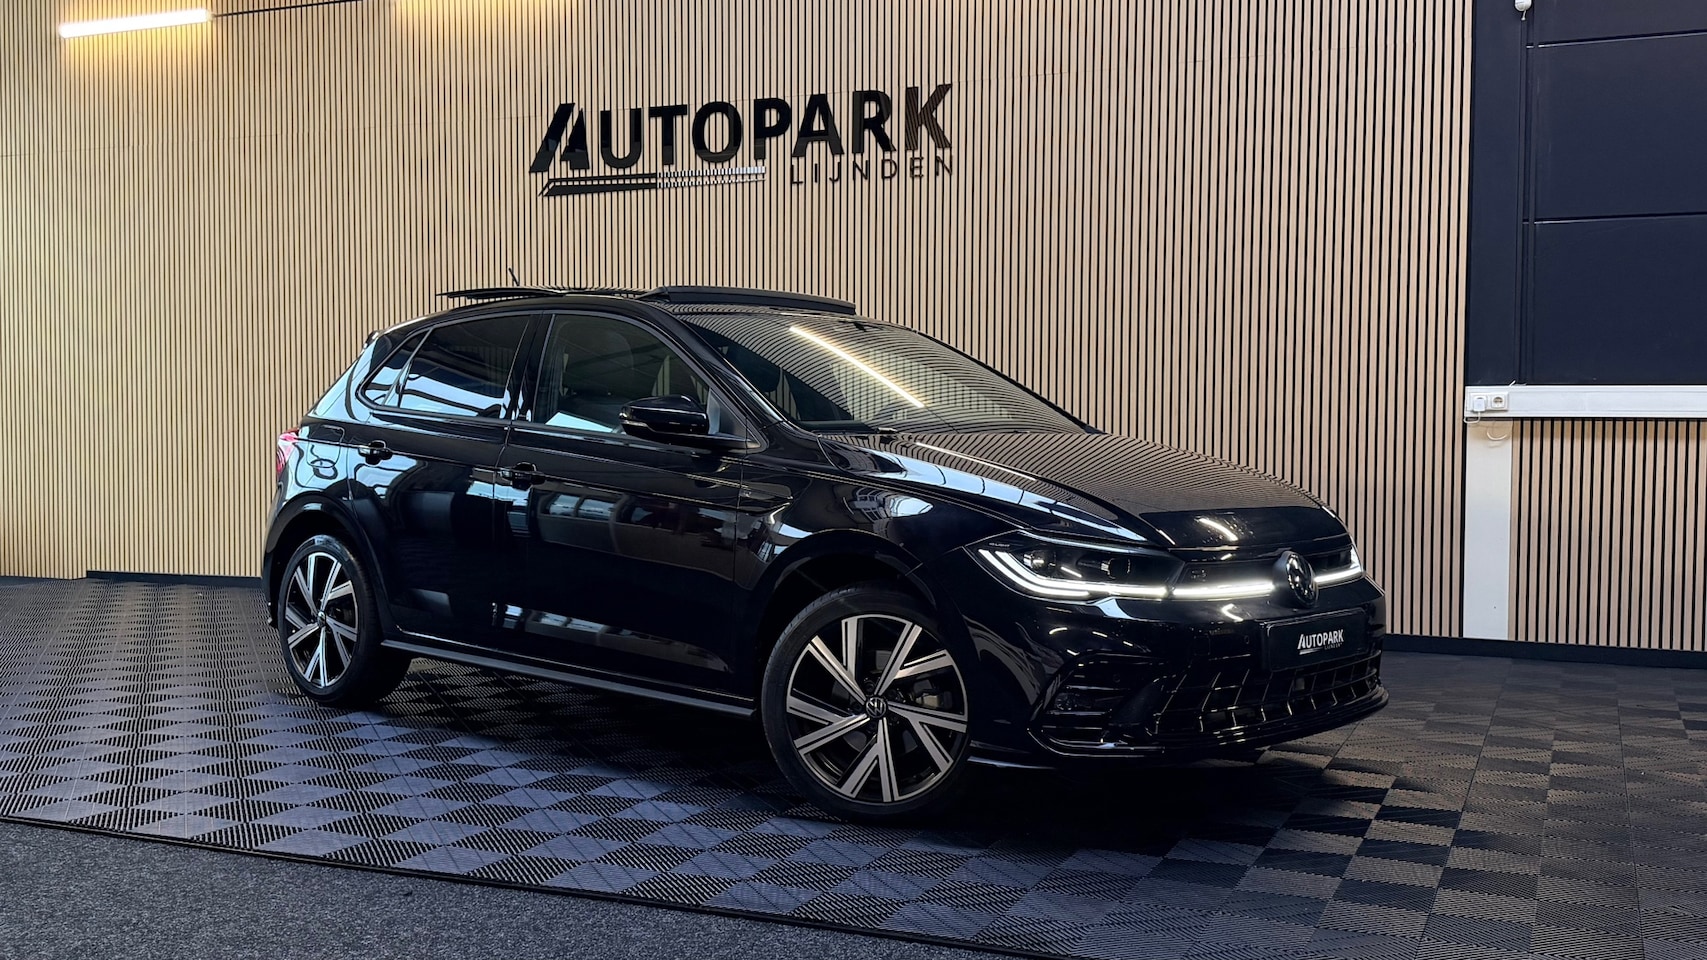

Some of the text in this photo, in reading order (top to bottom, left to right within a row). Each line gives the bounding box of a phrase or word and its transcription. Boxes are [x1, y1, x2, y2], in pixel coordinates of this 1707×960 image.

[529, 83, 953, 173] AUTOPARK
[790, 154, 953, 185] LIJNDEN
[1297, 629, 1344, 650] AUTOPARK
